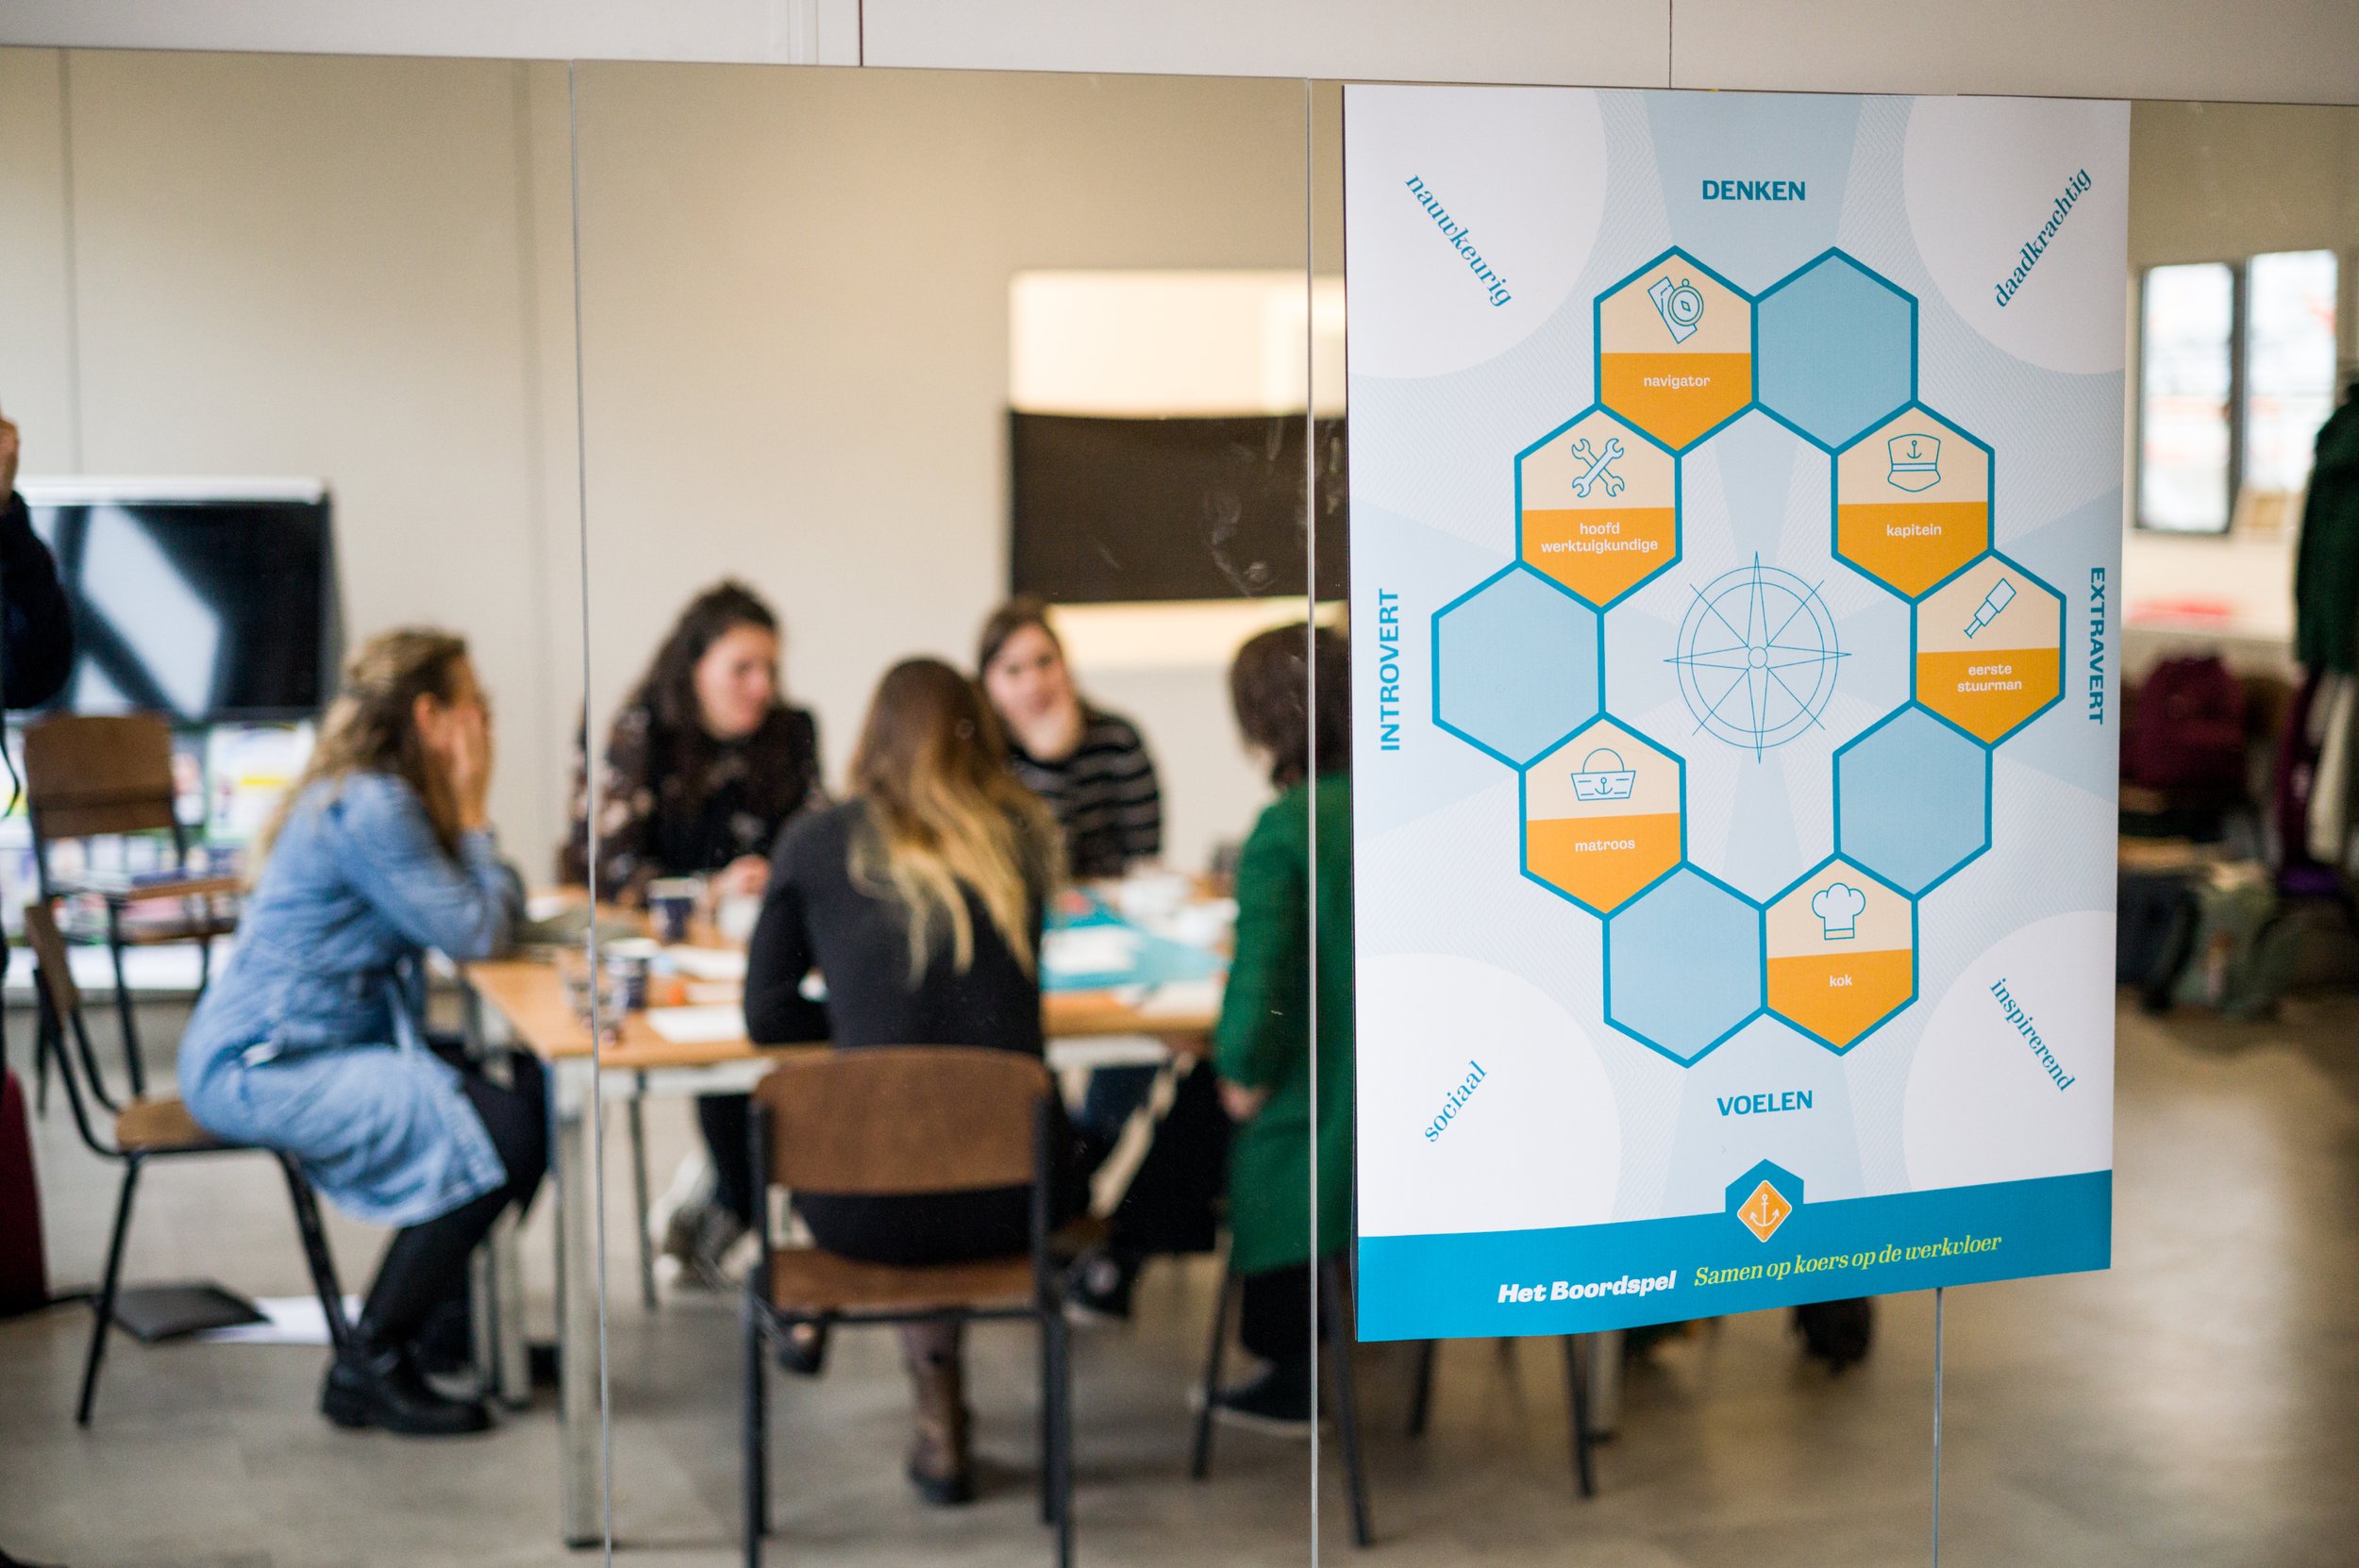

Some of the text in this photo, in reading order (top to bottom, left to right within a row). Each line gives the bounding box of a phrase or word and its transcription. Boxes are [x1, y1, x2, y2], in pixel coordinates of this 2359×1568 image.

[1702, 180, 1805, 201] DENKEN
[1406, 175, 1511, 308] nauwkeurig
[1995, 168, 2092, 308] daadkrachtig
[1644, 375, 1710, 390] navigator
[1579, 522, 1620, 535] hoofd
[1886, 523, 1942, 539] kapitein
[1541, 538, 1658, 554] werktuigkundige
[2089, 567, 2105, 725] EXTRAVERT
[1379, 589, 1400, 751] INTROVERT
[1968, 663, 2012, 676] eerste
[1957, 679, 2022, 692] stuurman
[1575, 838, 1635, 852] matroos
[1829, 974, 1852, 988] kok
[1990, 977, 2076, 1092] inspirerend
[1425, 1059, 1487, 1143] sociaal
[1717, 1090, 1813, 1117] VOELEN
[1694, 1234, 2002, 1287] Samen op koers op de werkvloer
[1497, 1270, 1677, 1304] Het Boordspel
